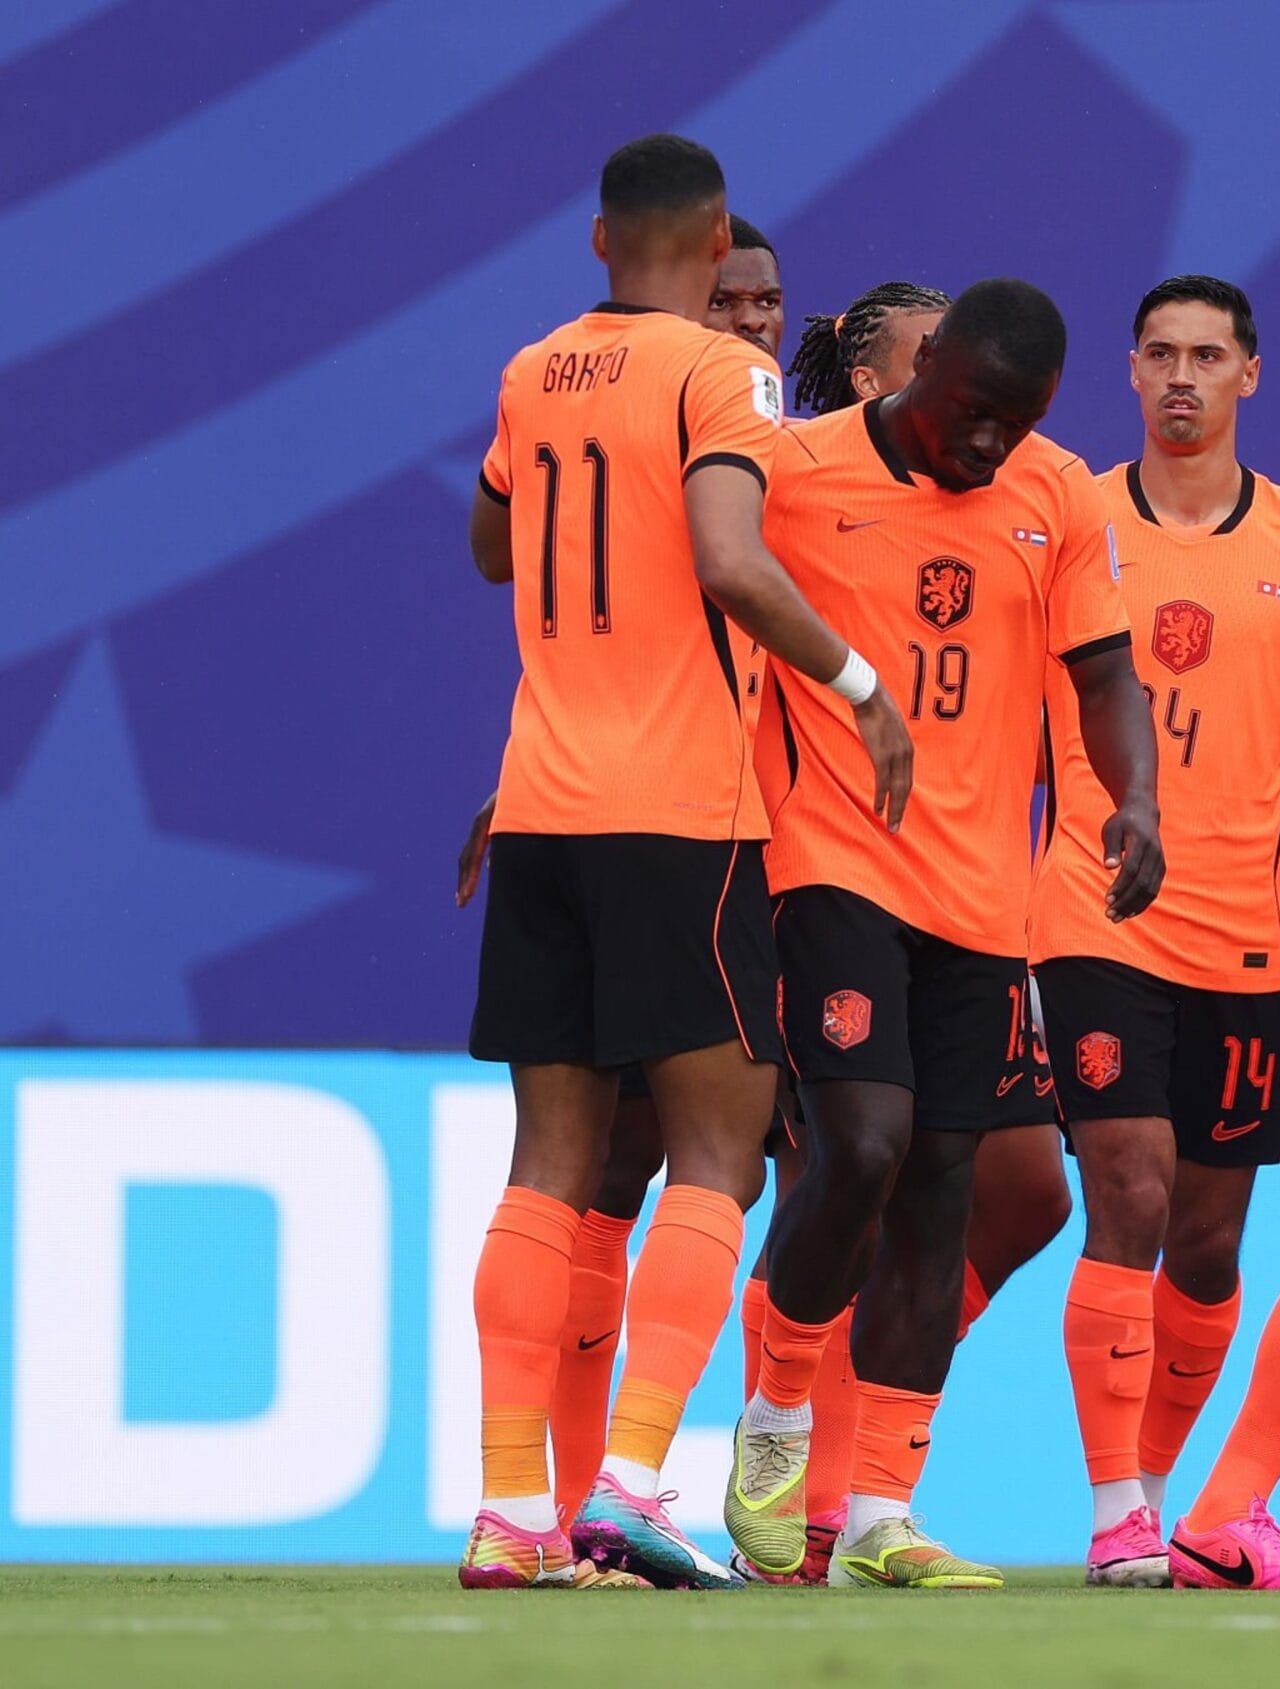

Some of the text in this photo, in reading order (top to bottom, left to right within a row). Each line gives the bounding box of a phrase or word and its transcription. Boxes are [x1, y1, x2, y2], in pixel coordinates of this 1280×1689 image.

[543, 346, 628, 393] GAKPO
[534, 437, 611, 639] 11
[908, 640, 970, 721] 19
[1221, 1035, 1276, 1111] 14
